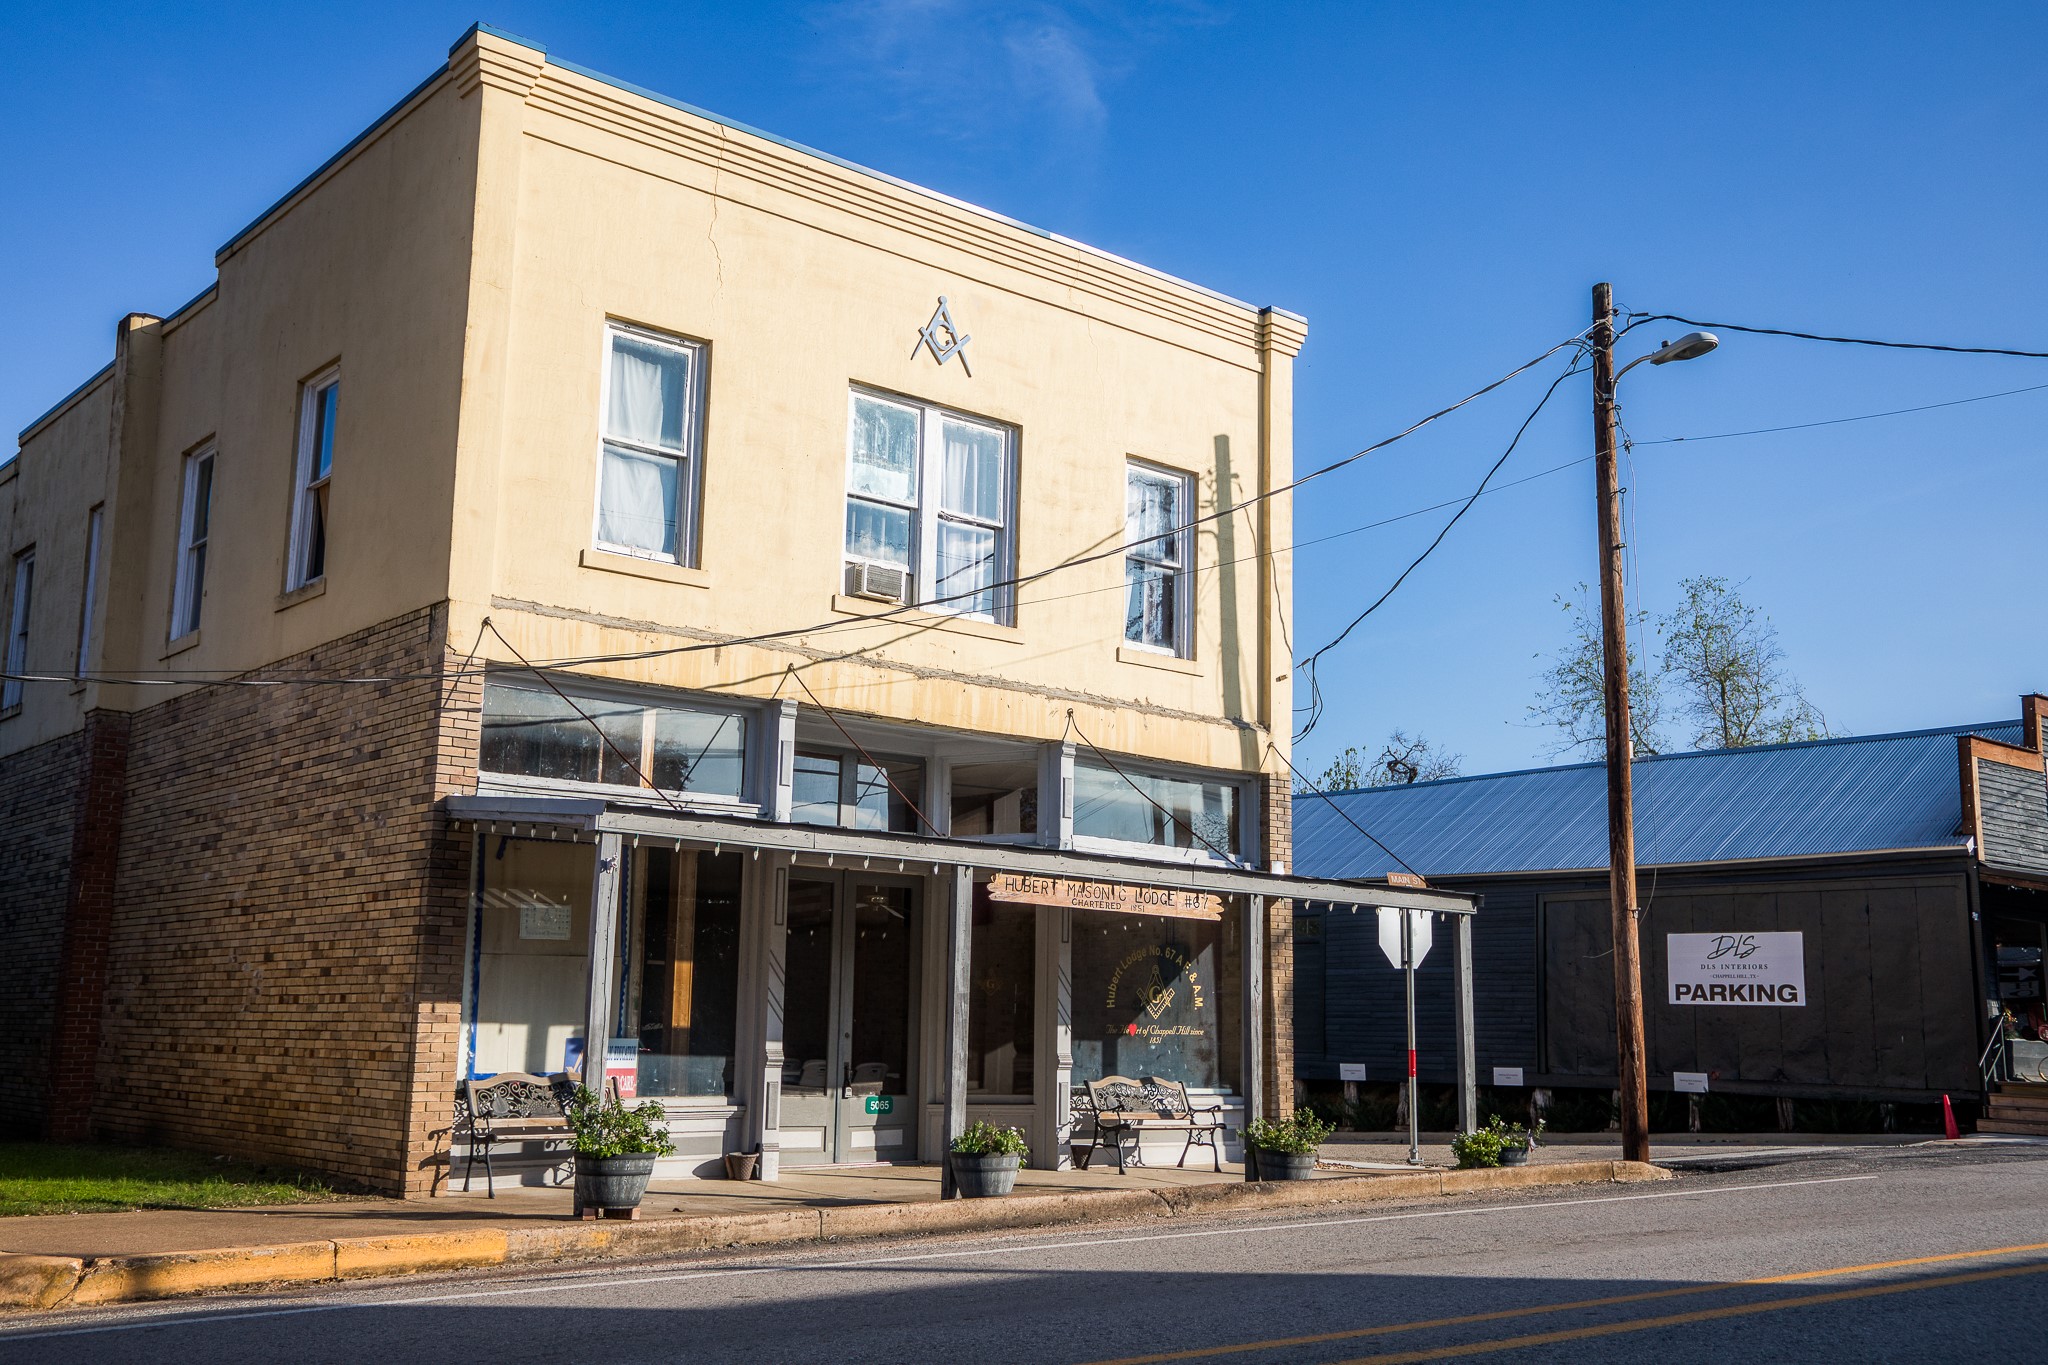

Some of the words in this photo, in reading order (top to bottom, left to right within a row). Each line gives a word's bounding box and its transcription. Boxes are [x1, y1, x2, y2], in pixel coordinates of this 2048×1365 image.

[1391, 875, 1410, 884] MAIN
[1005, 877, 1058, 895] HUBERT
[1066, 882, 1127, 902] MASONIC
[1135, 888, 1176, 907] LODGE
[1071, 898, 1122, 910] CHARTERED
[1130, 904, 1145, 913] 1851
[1706, 934, 1761, 960] DLS
[1106, 967, 1123, 1008] Hubert
[1120, 947, 1146, 969] Lodge
[1149, 945, 1163, 957] No.
[1165, 947, 1176, 960] 67
[1189, 972, 1198, 983] &
[1675, 983, 1798, 1003] PARKING
[1106, 1024, 1118, 1034] The
[1120, 1024, 1141, 1037] Hert
[1142, 1026, 1150, 1037] of
[1150, 1024, 1177, 1038] Chappell
[1176, 1025, 1191, 1035] Hill
[1190, 1028, 1204, 1036] since
[870, 1100, 890, 1111] 5065
